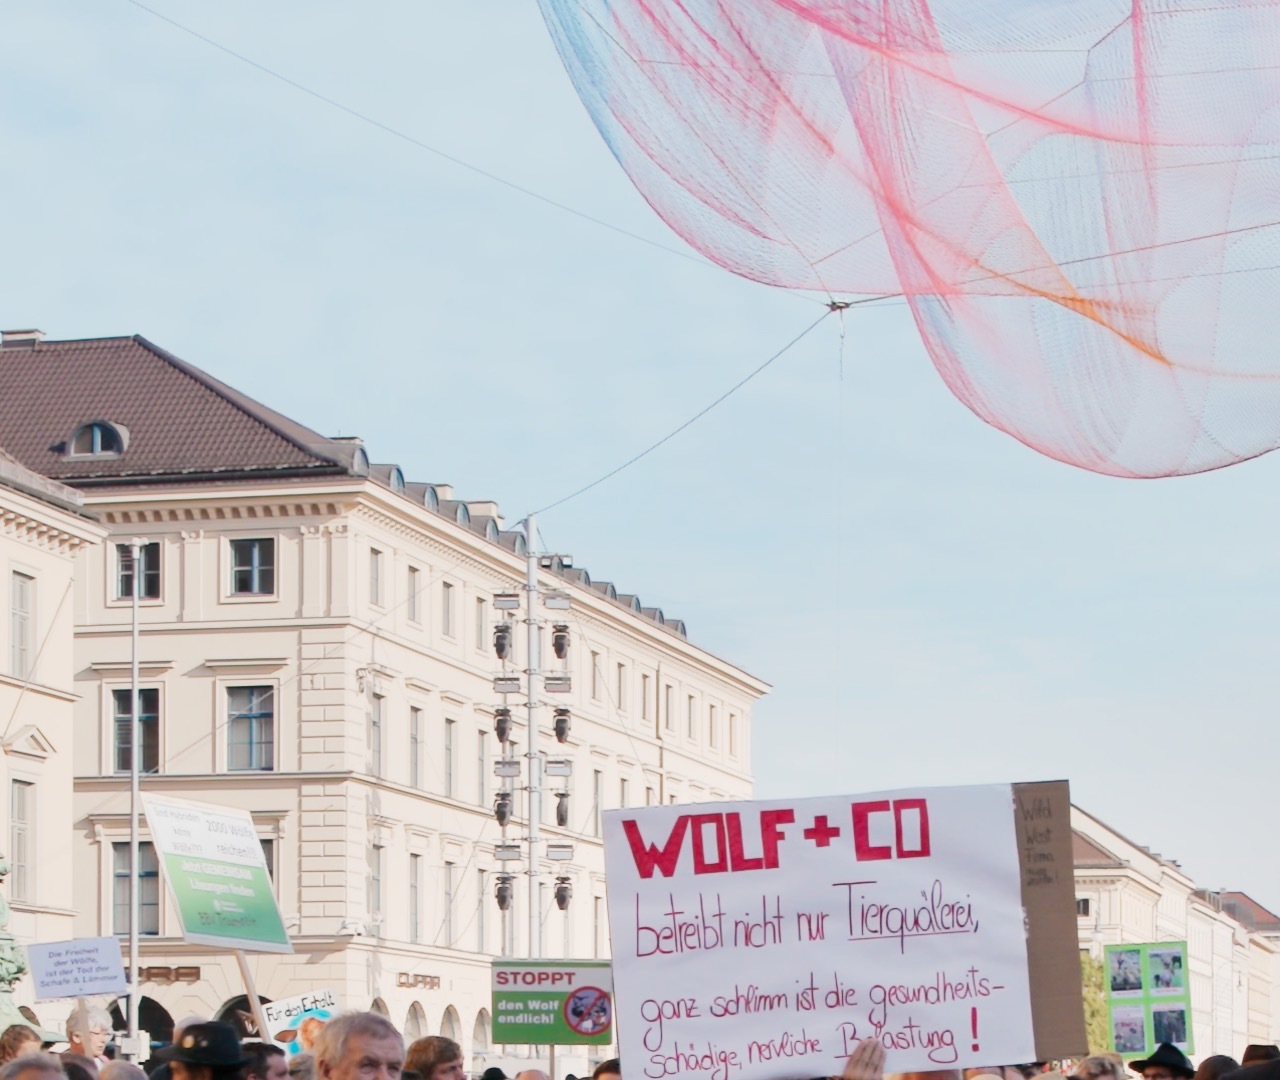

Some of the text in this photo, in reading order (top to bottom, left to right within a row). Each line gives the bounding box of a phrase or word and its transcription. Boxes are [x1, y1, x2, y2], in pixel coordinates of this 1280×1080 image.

[622, 809, 795, 879] WOLF
[851, 798, 931, 862] CO
[636, 879, 980, 957] betreibt nicht nur Tierquälerei,
[496, 971, 577, 986] STOPPT
[497, 1000, 559, 1011] den Wolf
[497, 1013, 555, 1025] endlich!
[640, 964, 1005, 1052] ganz schlimm ist die gesundheits-
[833, 1016, 959, 1064] Blastung
